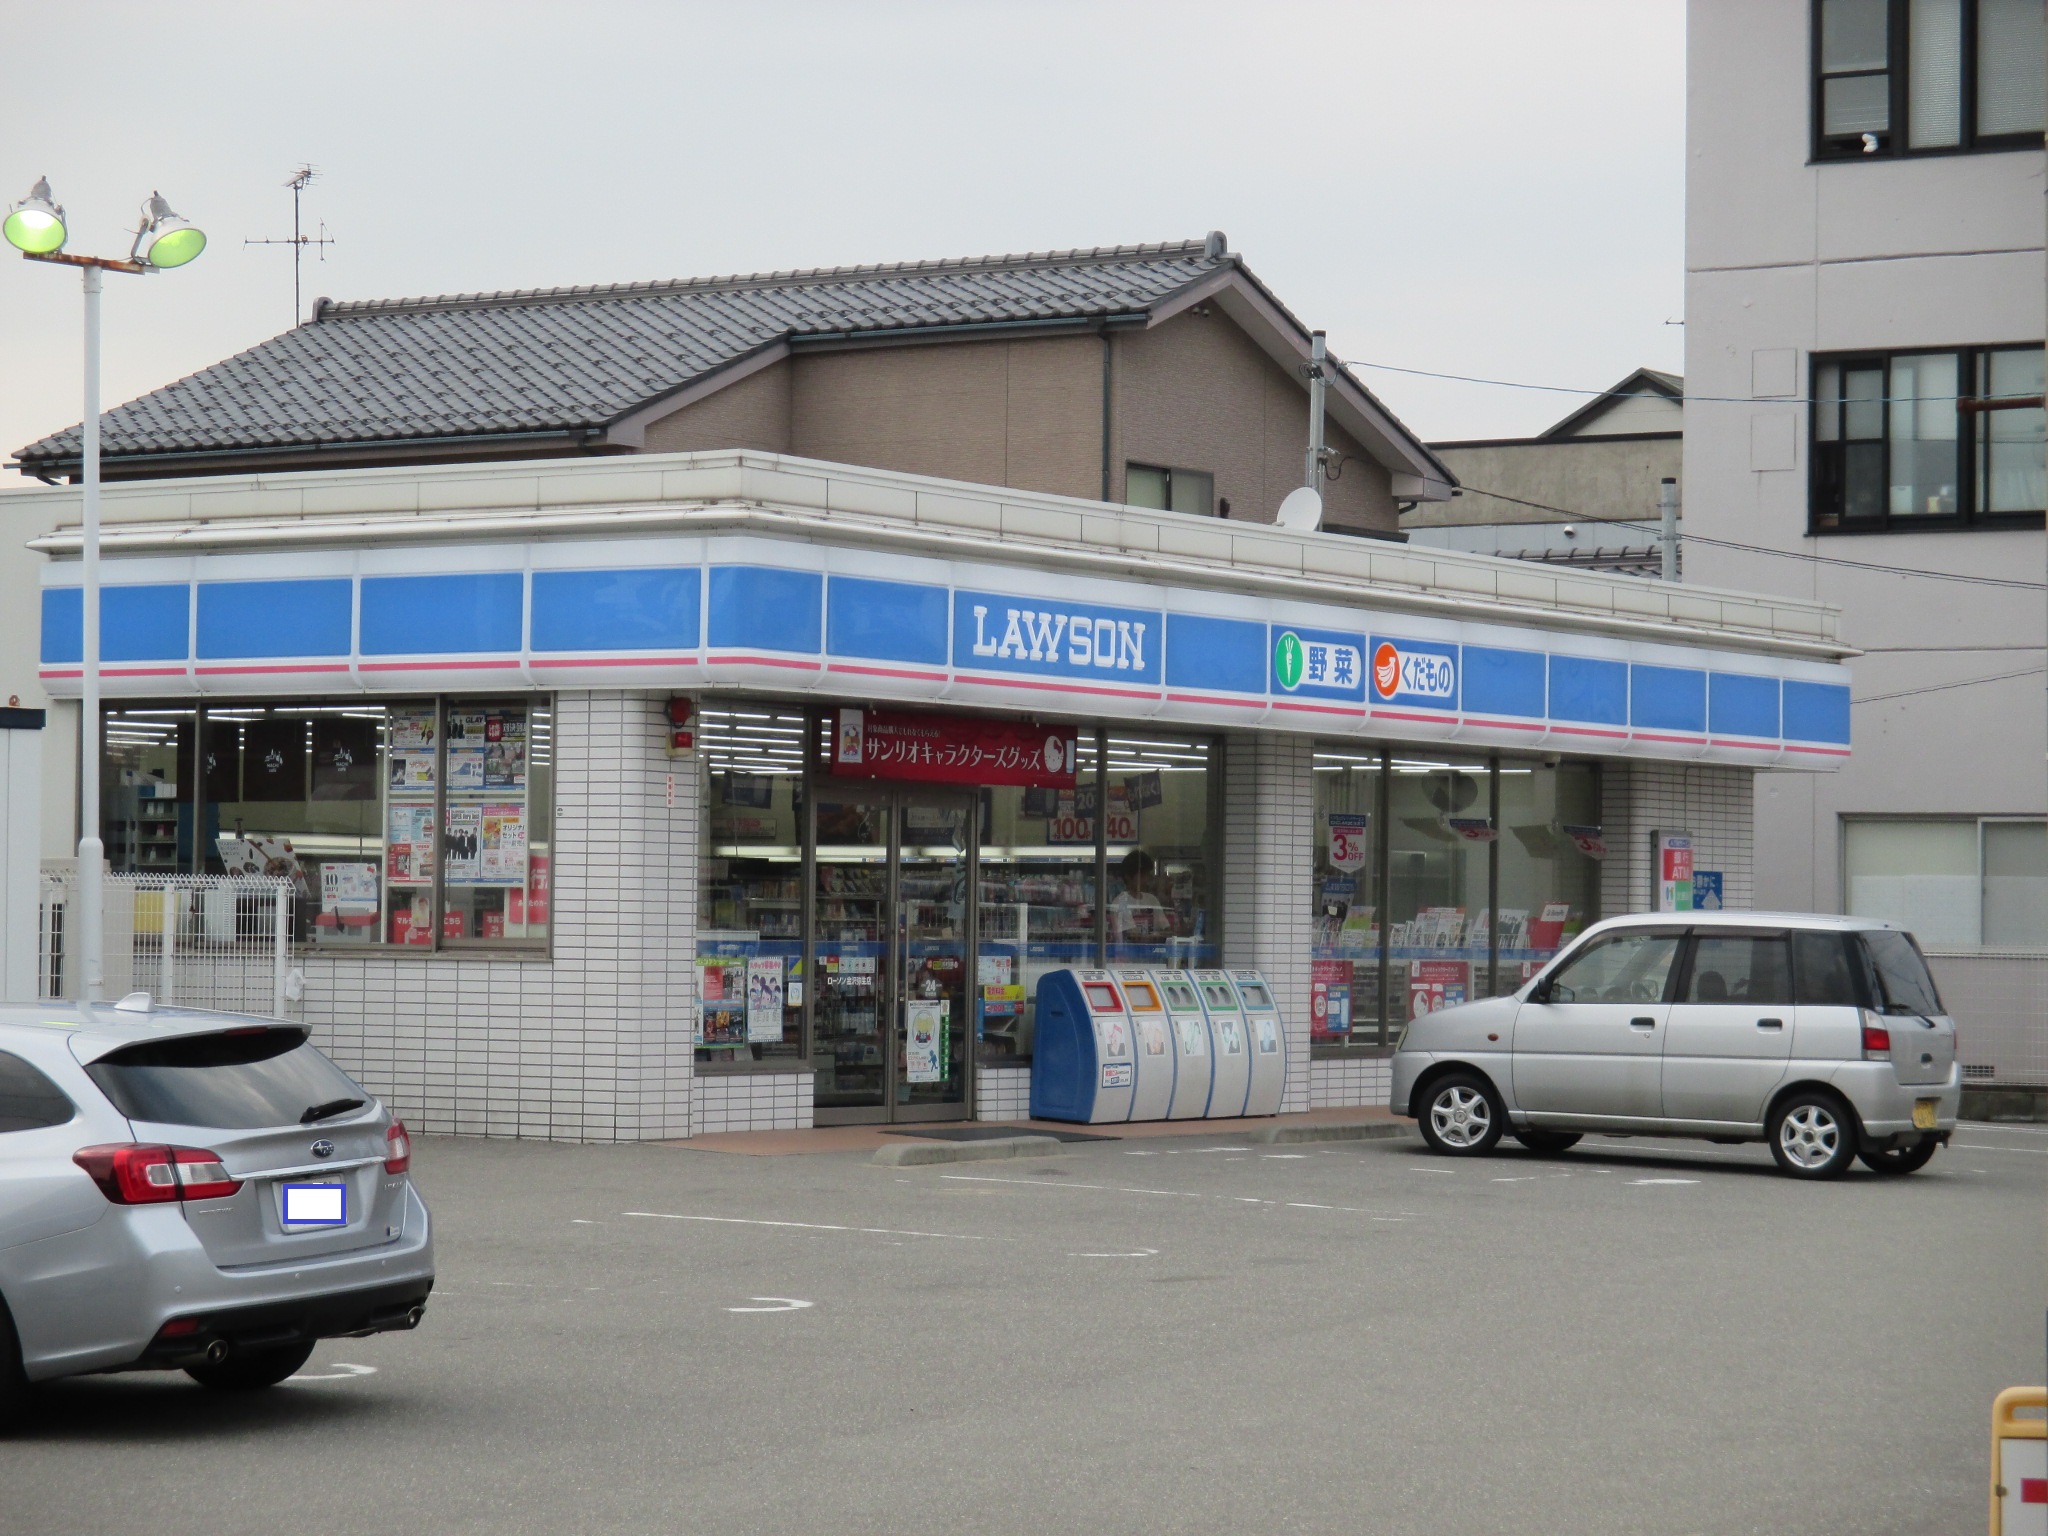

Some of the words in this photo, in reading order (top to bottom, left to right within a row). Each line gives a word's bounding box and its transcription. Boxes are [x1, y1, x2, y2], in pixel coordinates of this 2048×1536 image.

[973, 605, 1146, 671] LAWSON
[1307, 645, 1354, 686] 野菜
[1401, 656, 1451, 693] くだもの
[465, 716, 484, 724] GLAY
[866, 737, 1041, 770] サンリオキャラクターズグッズ
[502, 832, 517, 840] セット
[1348, 852, 1364, 861] OFF
[530, 869, 548, 890] 行
[1671, 866, 1690, 880] ATM
[517, 899, 548, 908] あたのカー
[827, 976, 872, 986] ローソン金沢弥生店
[925, 979, 937, 992] 24
